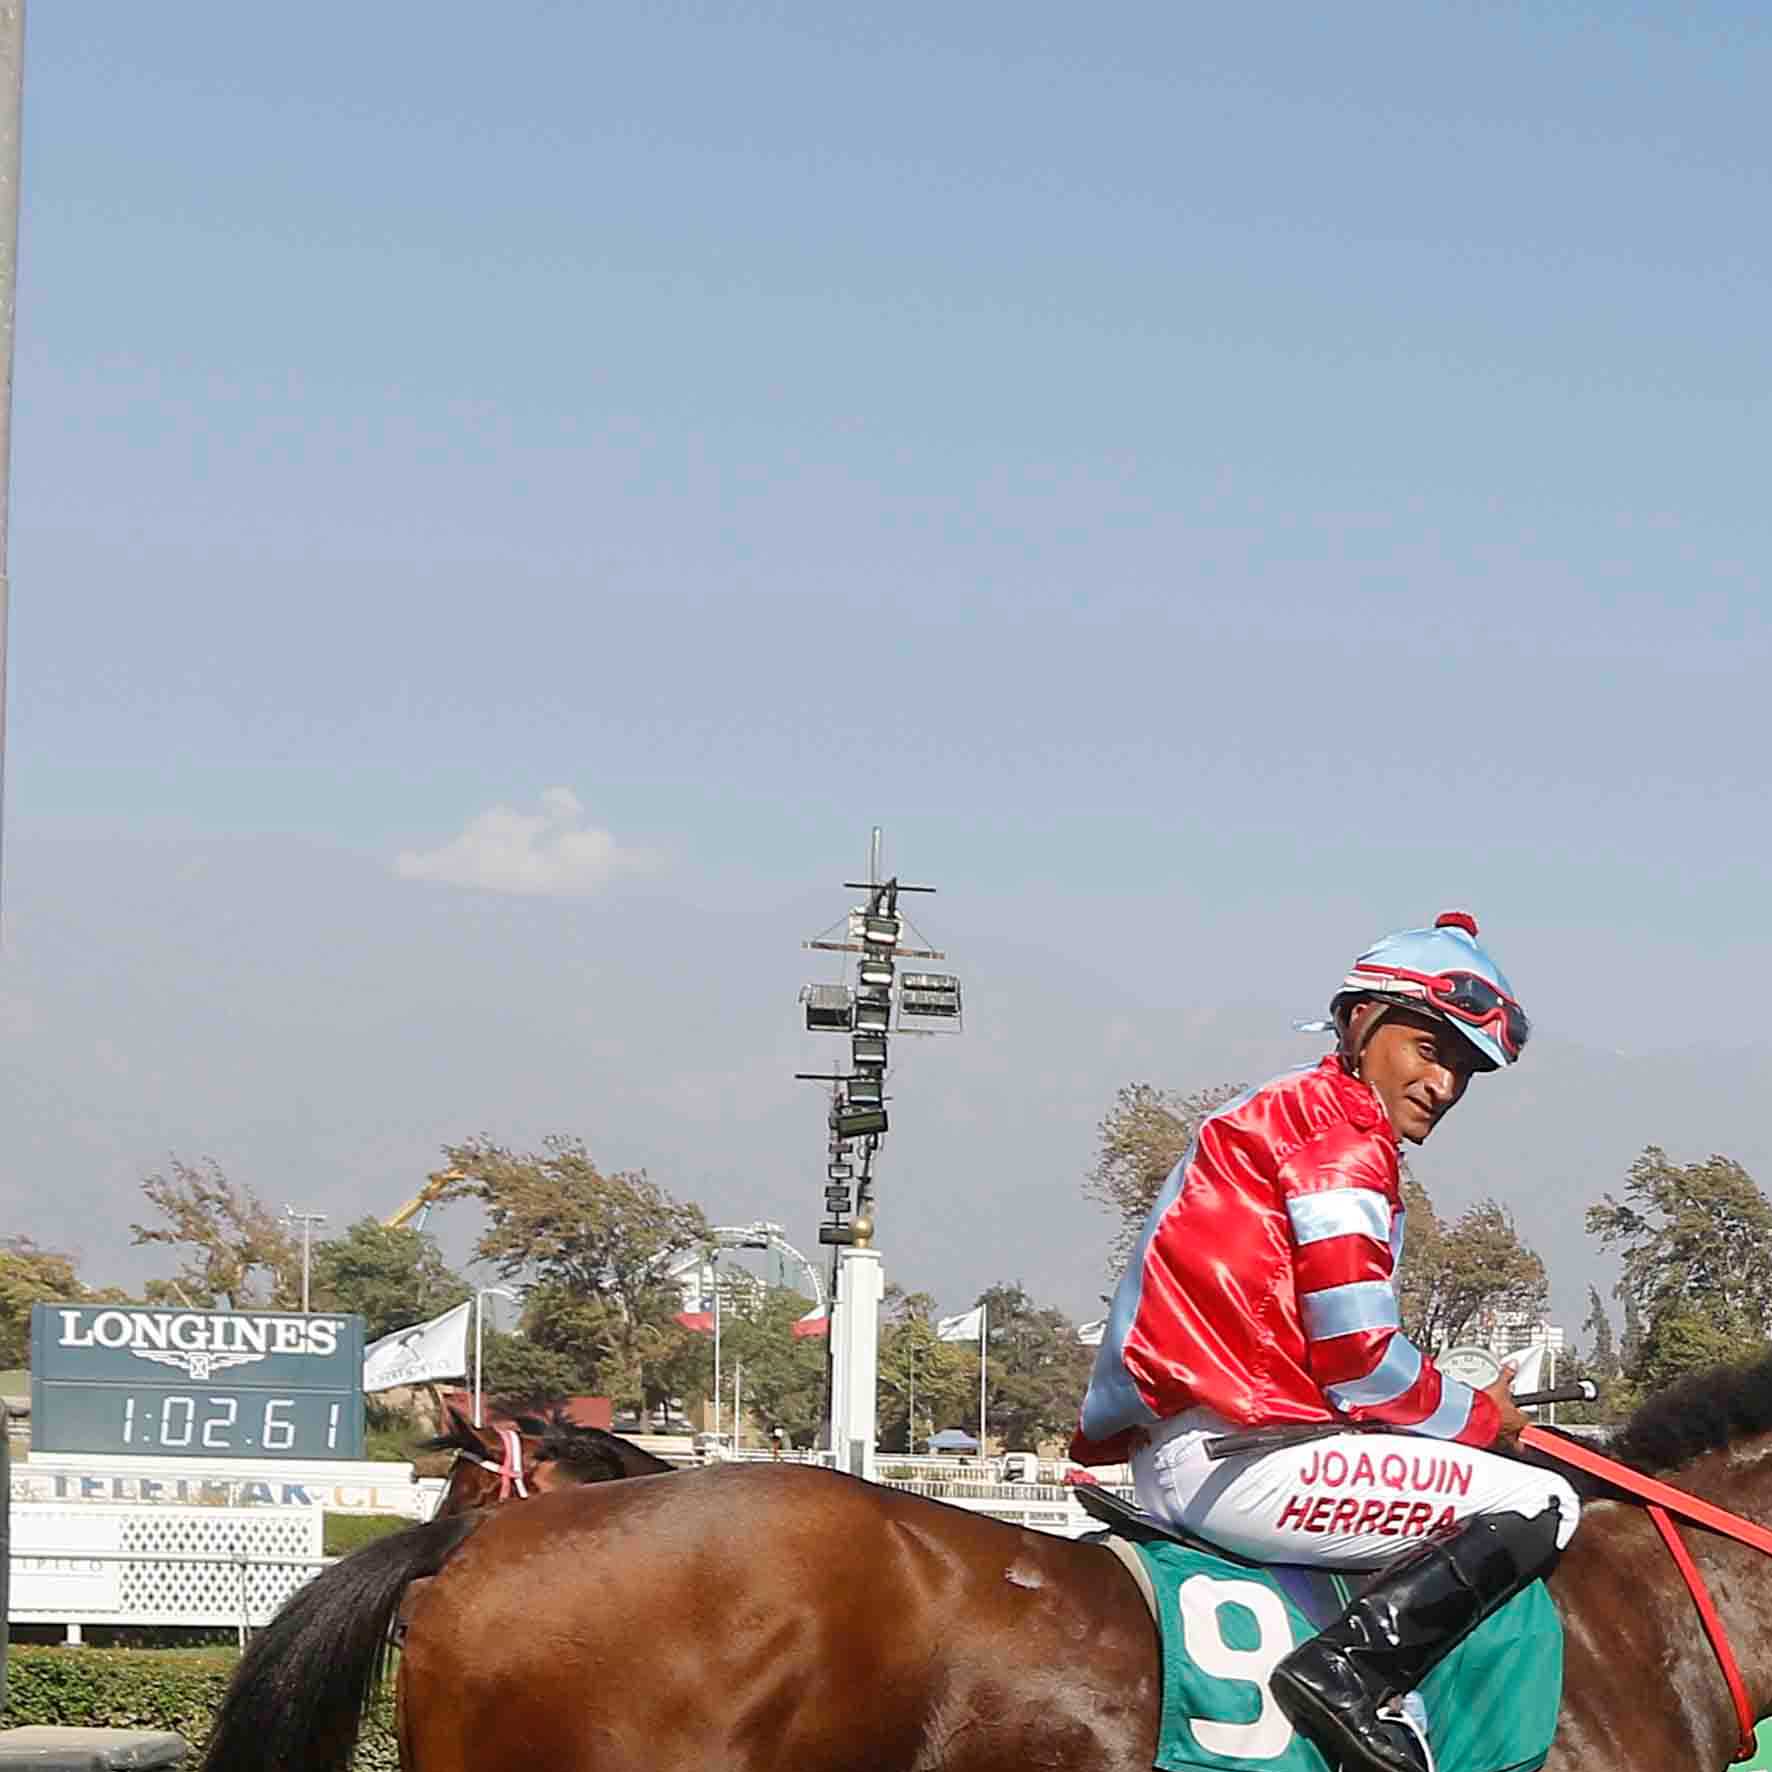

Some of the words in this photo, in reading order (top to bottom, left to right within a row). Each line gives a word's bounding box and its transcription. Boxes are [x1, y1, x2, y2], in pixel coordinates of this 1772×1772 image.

[58, 1310, 338, 1355] LONGINES
[1300, 1451, 1473, 1496] JOAQUIN
[1276, 1494, 1459, 1537] HERRERA
[1179, 1574, 1294, 1760] 9
